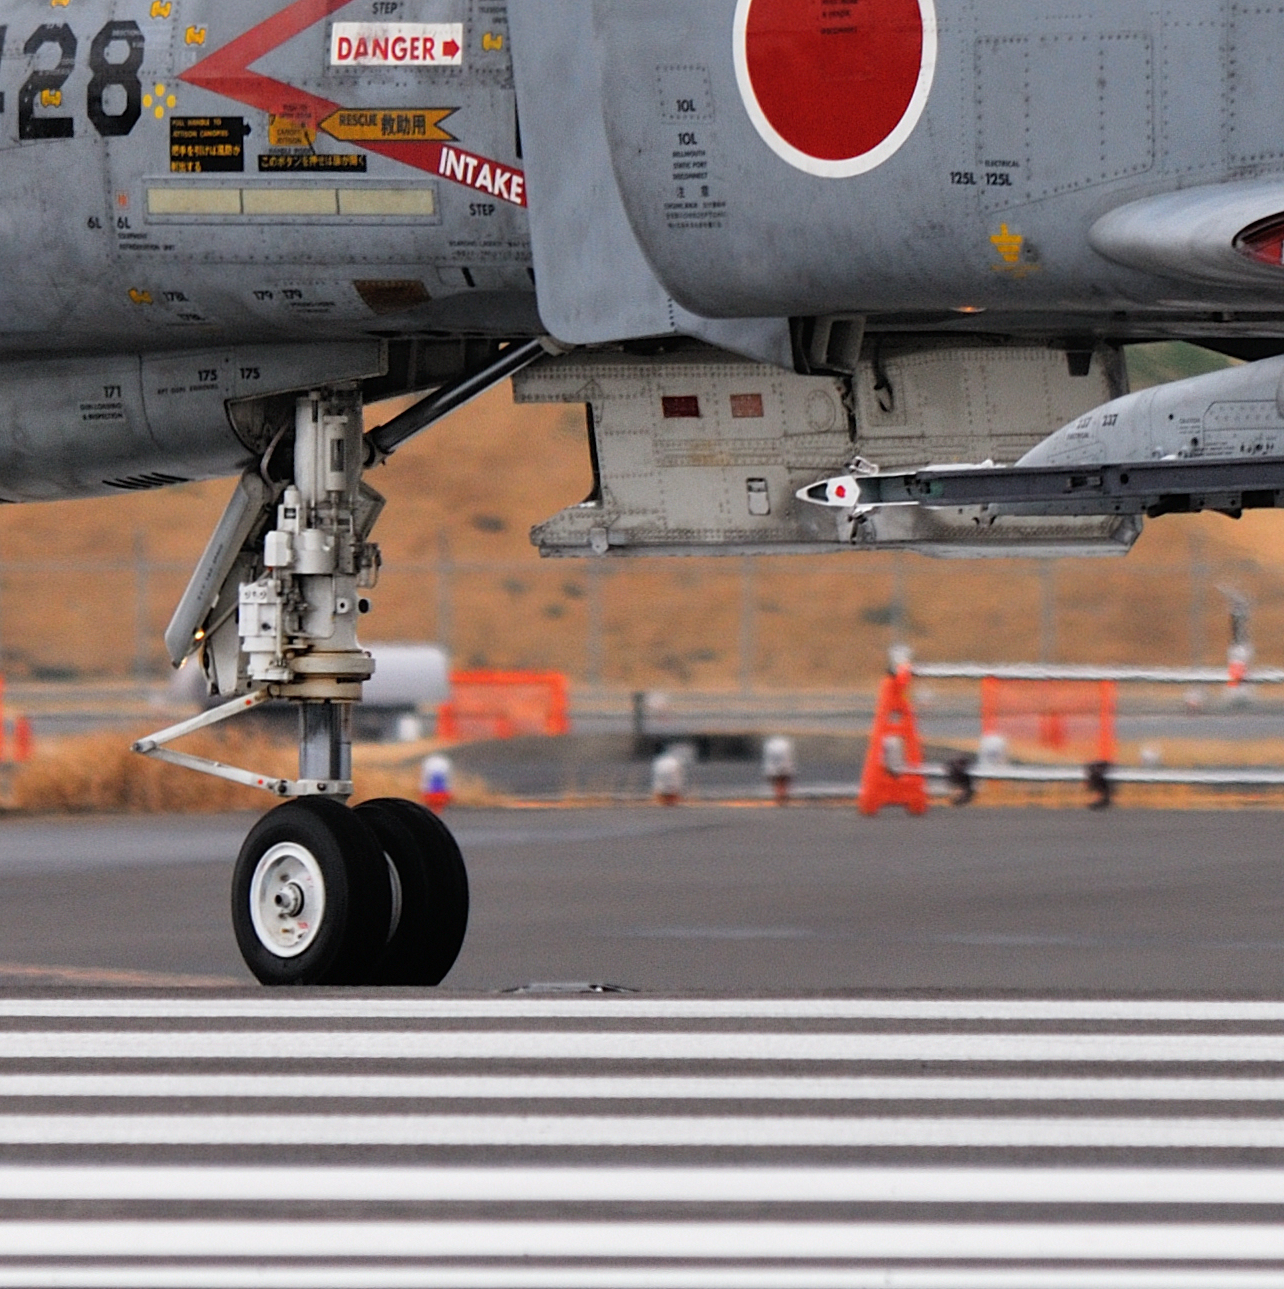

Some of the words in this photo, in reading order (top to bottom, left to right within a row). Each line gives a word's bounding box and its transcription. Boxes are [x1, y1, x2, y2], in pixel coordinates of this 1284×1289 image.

[371, 1, 399, 15] STEP
[336, 36, 435, 61] DANGER
[676, 98, 697, 113] 10L
[338, 113, 378, 128] RESCUE
[380, 113, 427, 137] 救助用
[677, 131, 698, 146] 10L
[438, 145, 525, 205] INTAKE
[949, 171, 978, 186] 125L
[985, 172, 1013, 187] 125L
[469, 203, 496, 218] STEP
[86, 216, 103, 229] 6L
[116, 216, 131, 229] 6L
[253, 290, 274, 301] 179
[281, 288, 303, 300] 179
[197, 369, 219, 382] 175
[239, 367, 261, 381] 175
[103, 385, 122, 398] 171
[1101, 413, 1119, 427] 237
